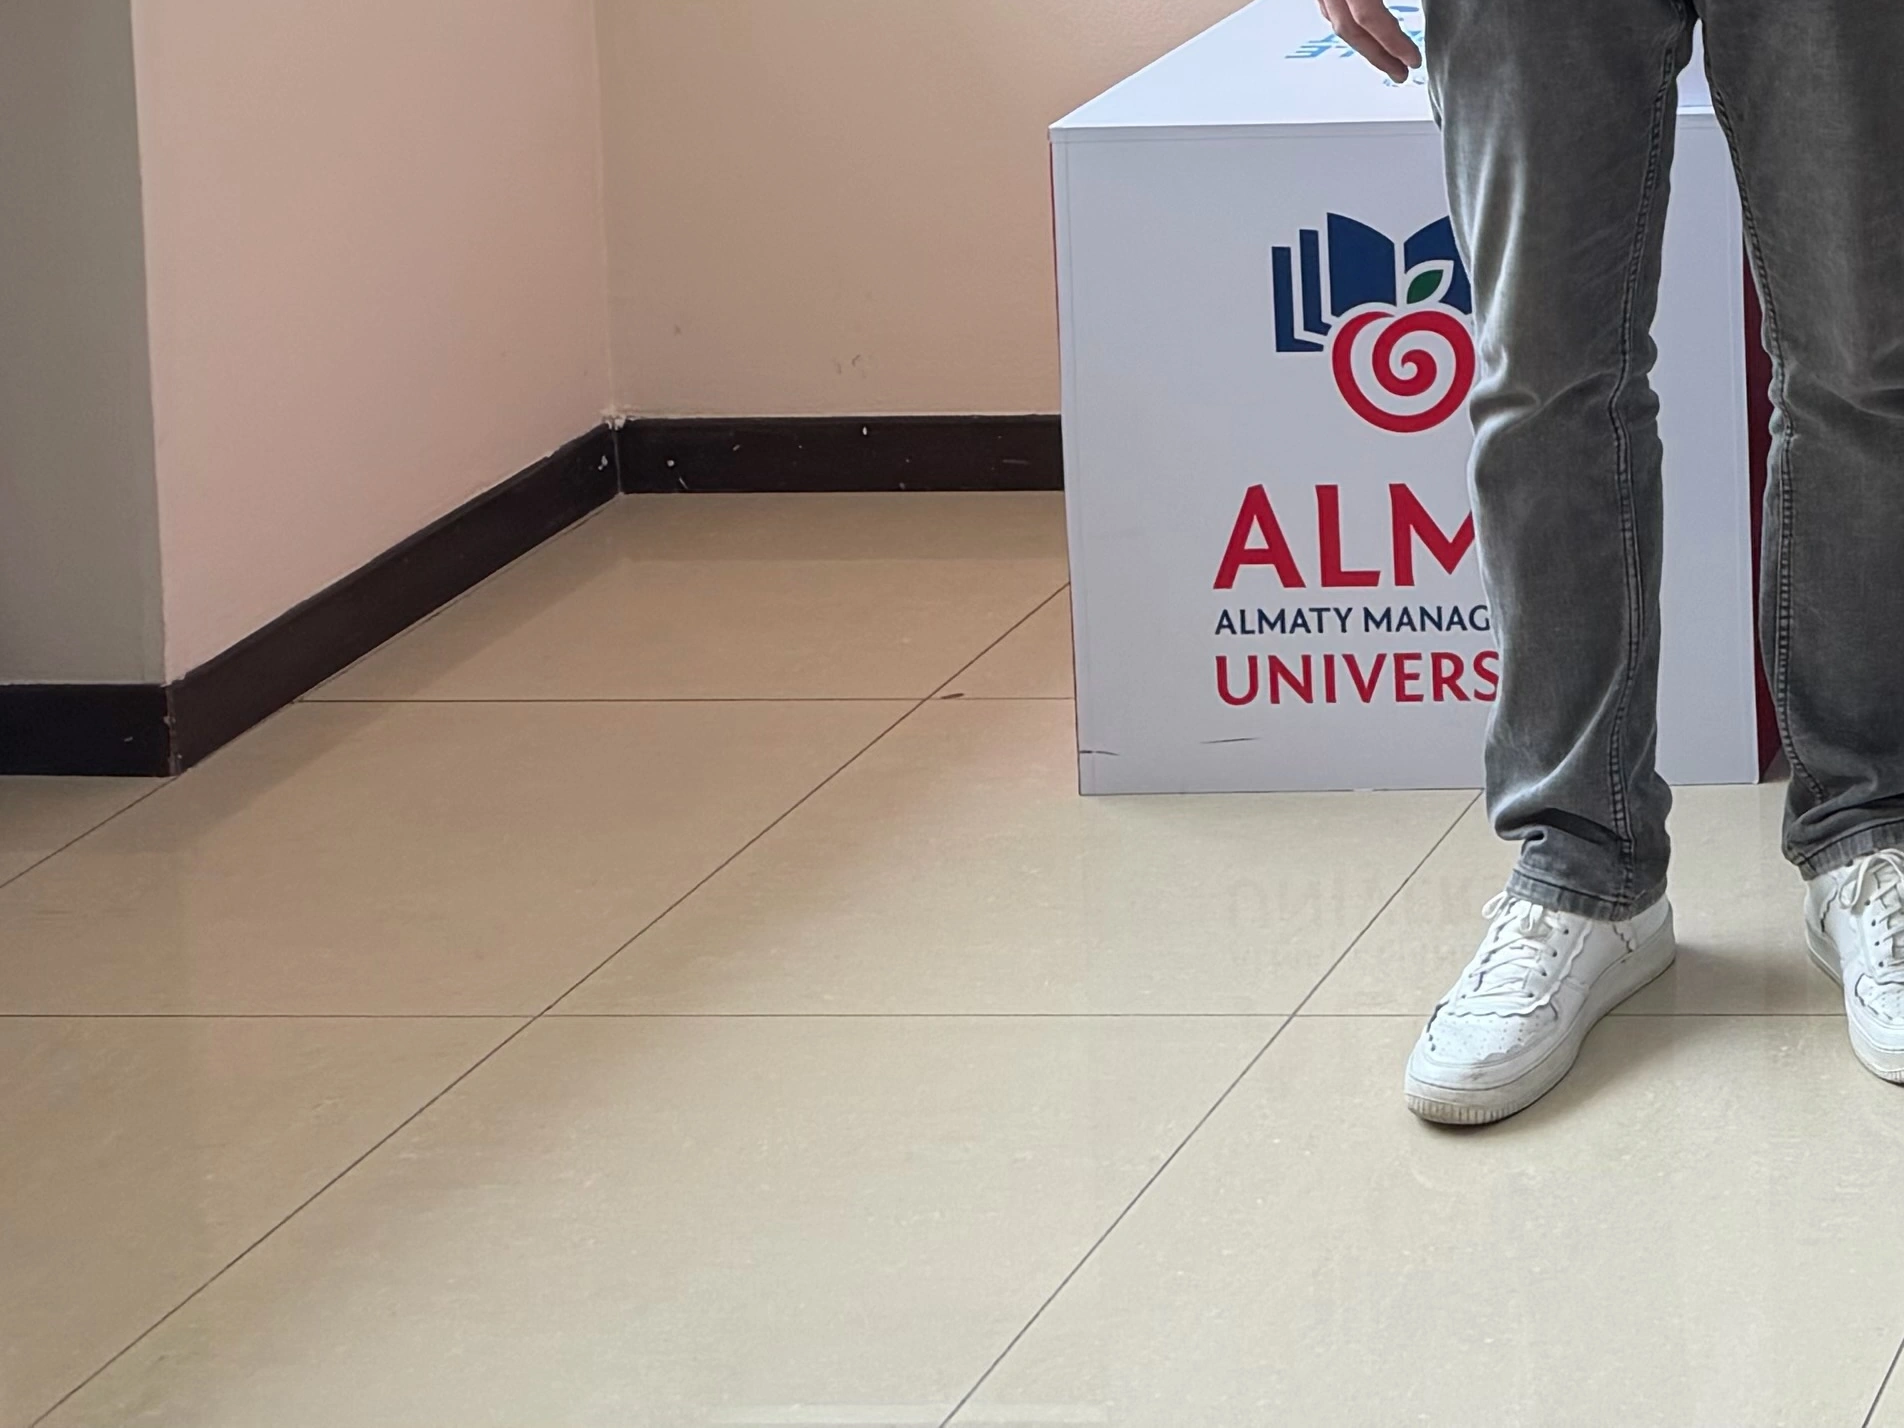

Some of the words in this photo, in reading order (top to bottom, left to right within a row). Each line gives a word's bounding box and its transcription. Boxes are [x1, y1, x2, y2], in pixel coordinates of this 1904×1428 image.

[1213, 484, 1477, 589] ALM
[1215, 606, 1354, 636] ALMATY
[1362, 605, 1490, 632] MANAG
[1214, 651, 1499, 706] UNIVERS
